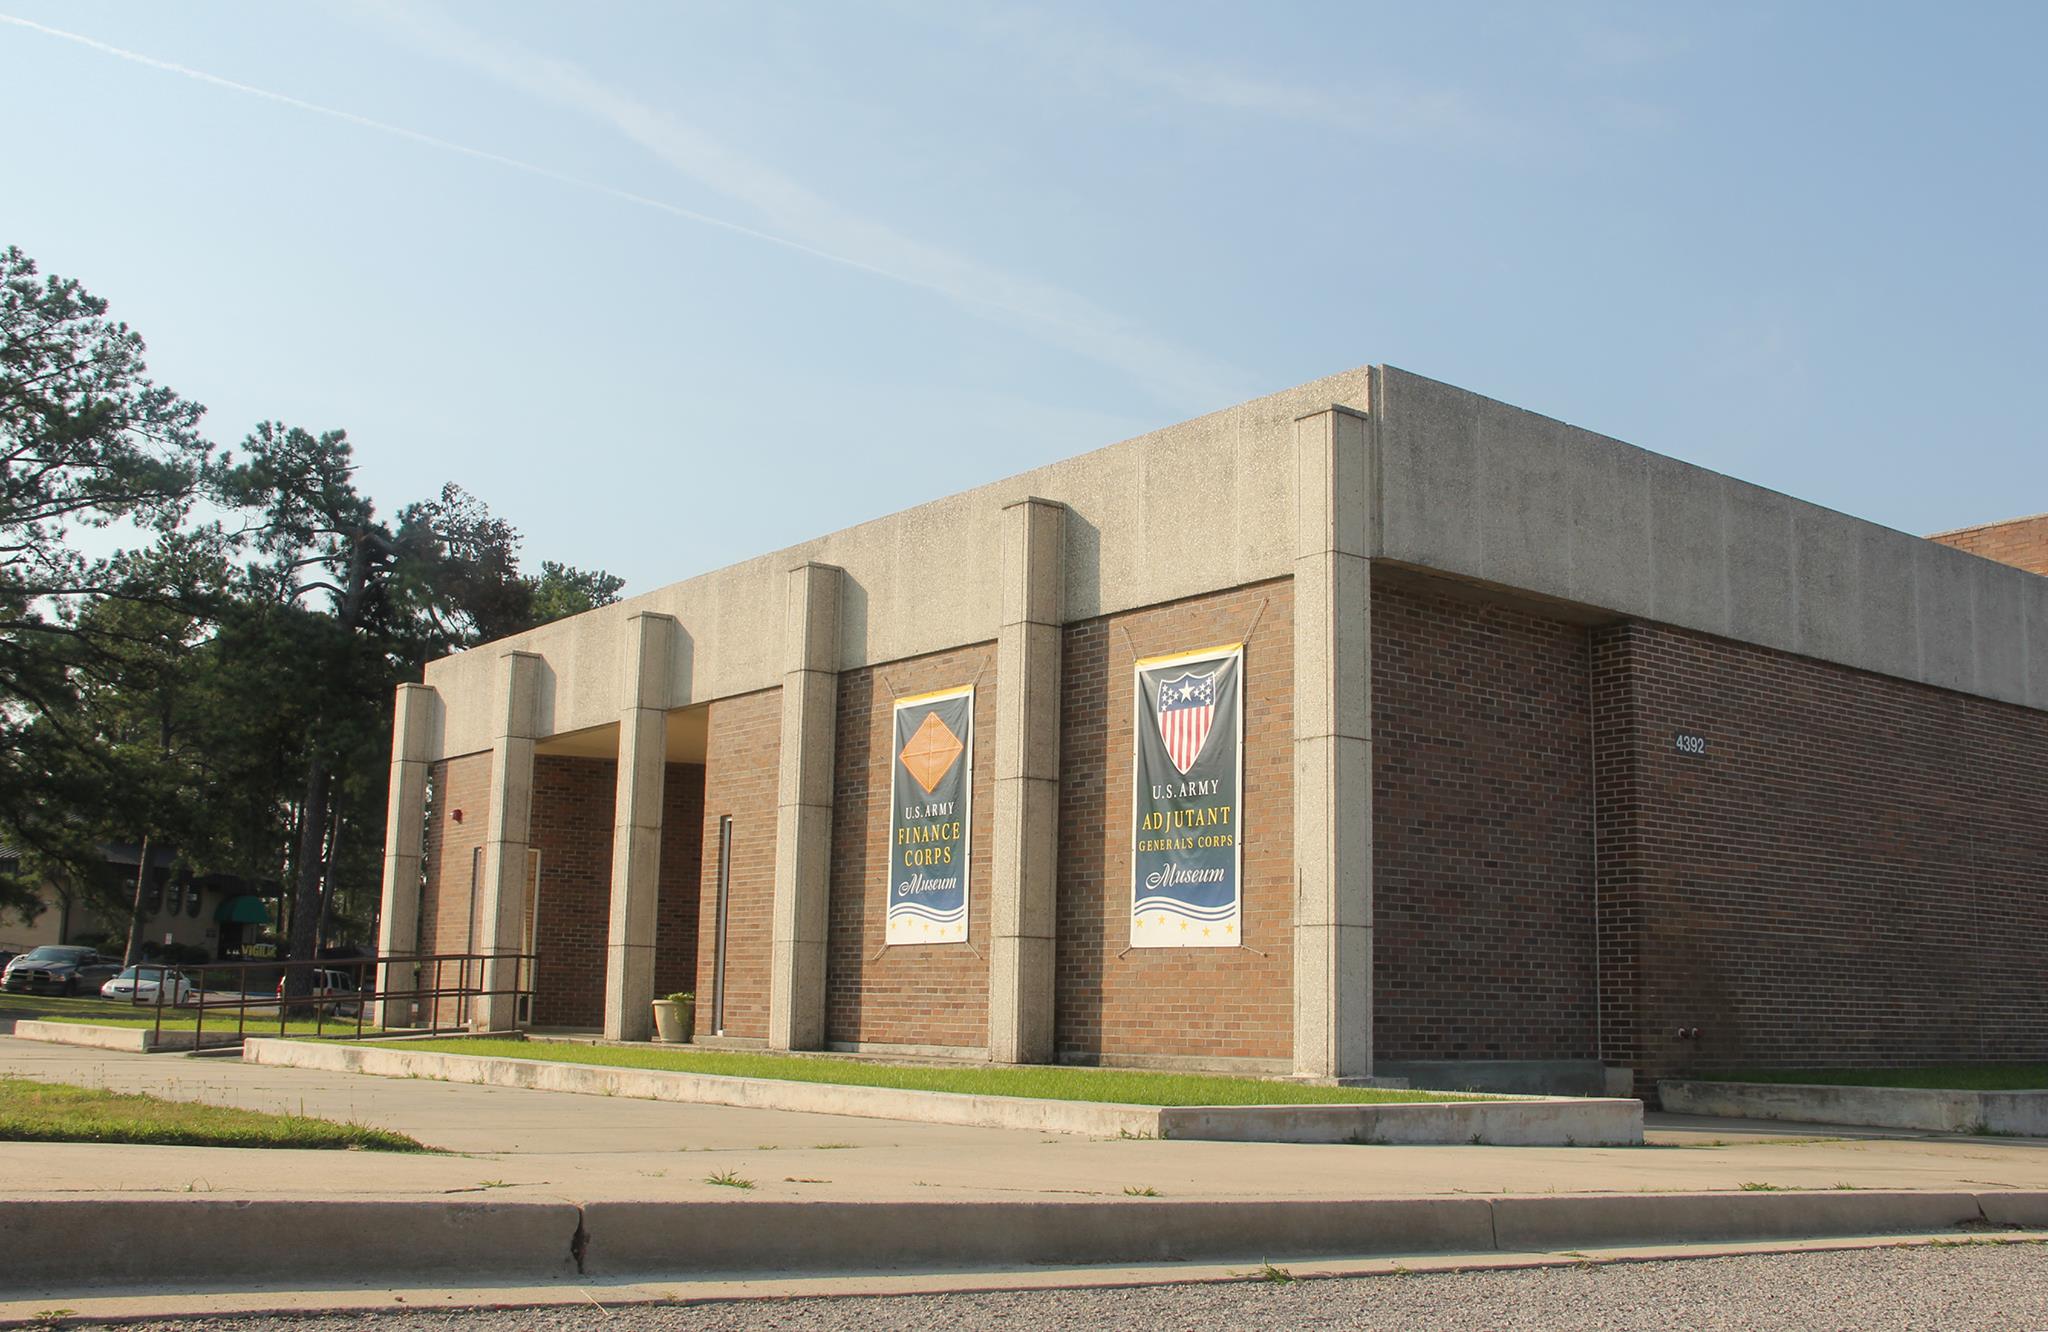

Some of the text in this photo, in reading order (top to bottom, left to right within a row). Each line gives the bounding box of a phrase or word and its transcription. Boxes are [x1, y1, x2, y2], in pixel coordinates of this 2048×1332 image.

[1676, 735, 1704, 754] 4392
[1152, 779, 1218, 799] U.S. ARMY
[905, 801, 954, 819] U.S. ARMY
[1142, 806, 1231, 833] ADJUTANT
[898, 822, 960, 845] FINANCE
[1197, 834, 1233, 849] CORPS
[904, 846, 951, 867] CORPS
[898, 873, 957, 896] Museum
[1145, 863, 1224, 889] Museum
